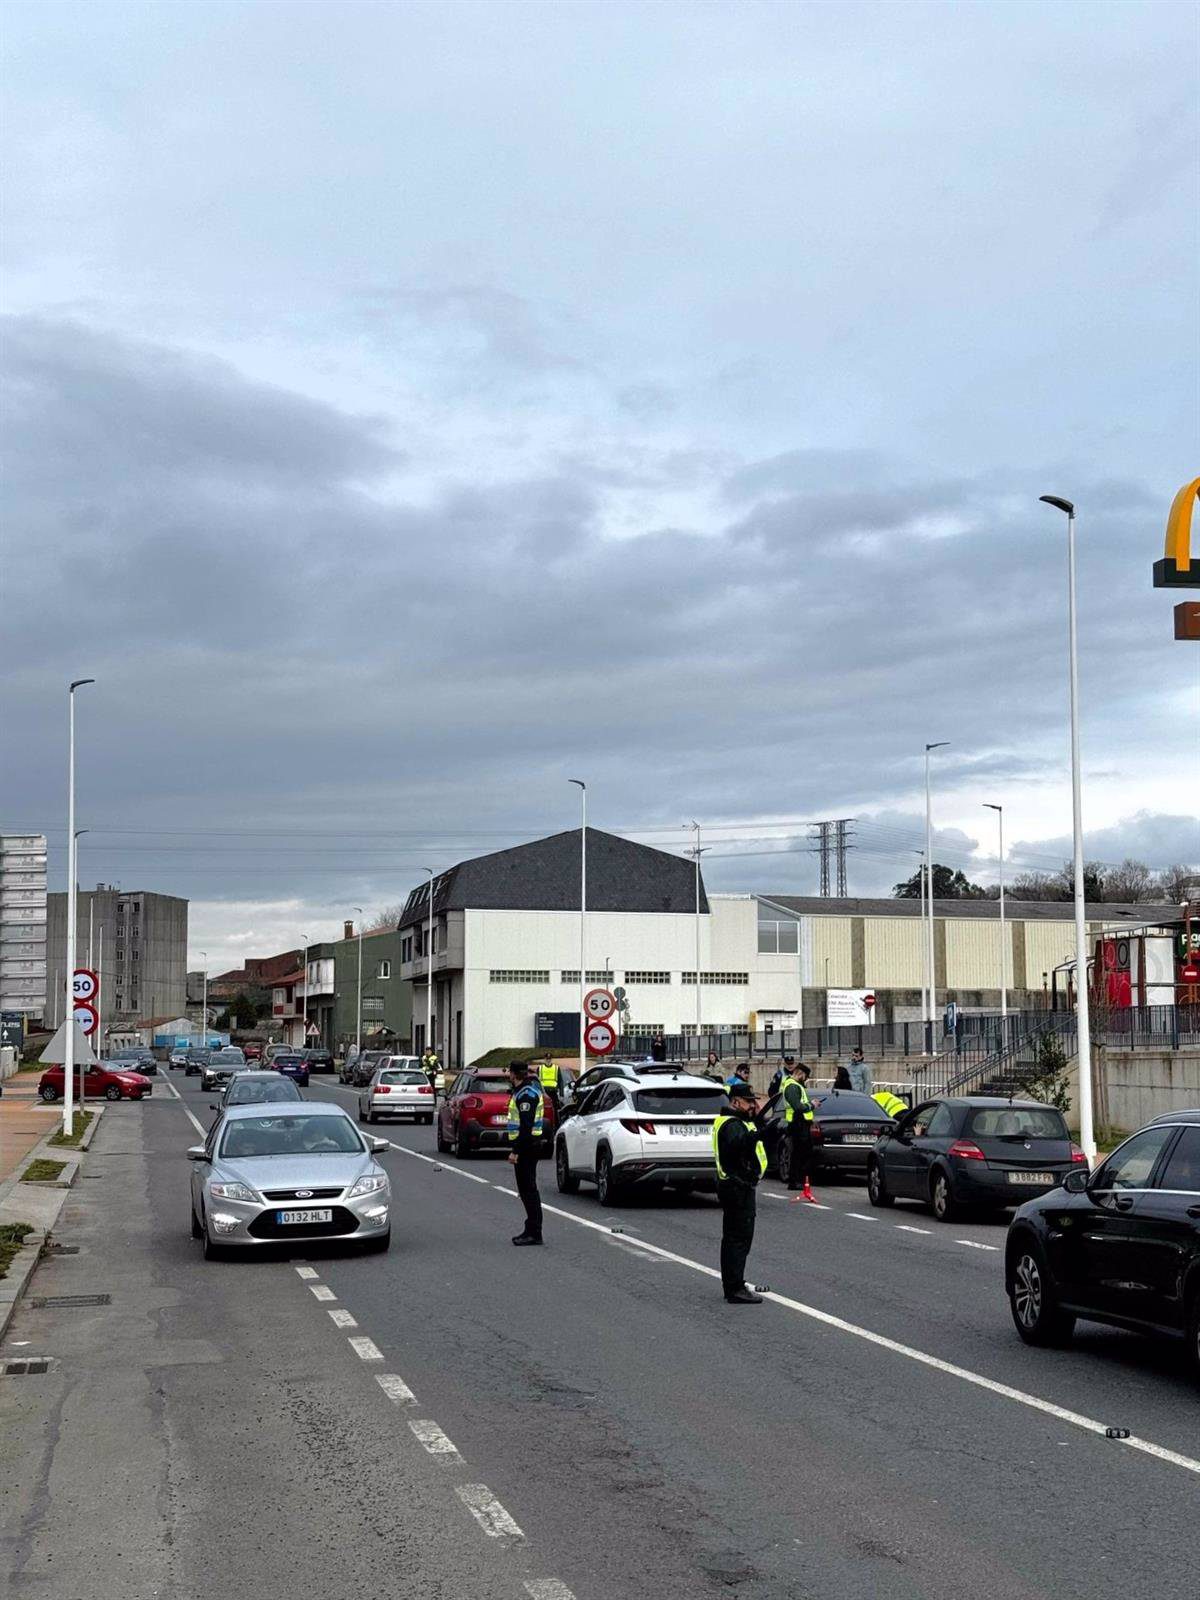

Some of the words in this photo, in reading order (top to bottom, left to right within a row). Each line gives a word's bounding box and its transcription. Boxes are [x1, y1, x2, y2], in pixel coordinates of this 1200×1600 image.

[73, 981, 91, 992] 50
[590, 1000, 610, 1011] 50
[283, 1212, 309, 1223] 0132
[310, 1210, 331, 1221] HLT
